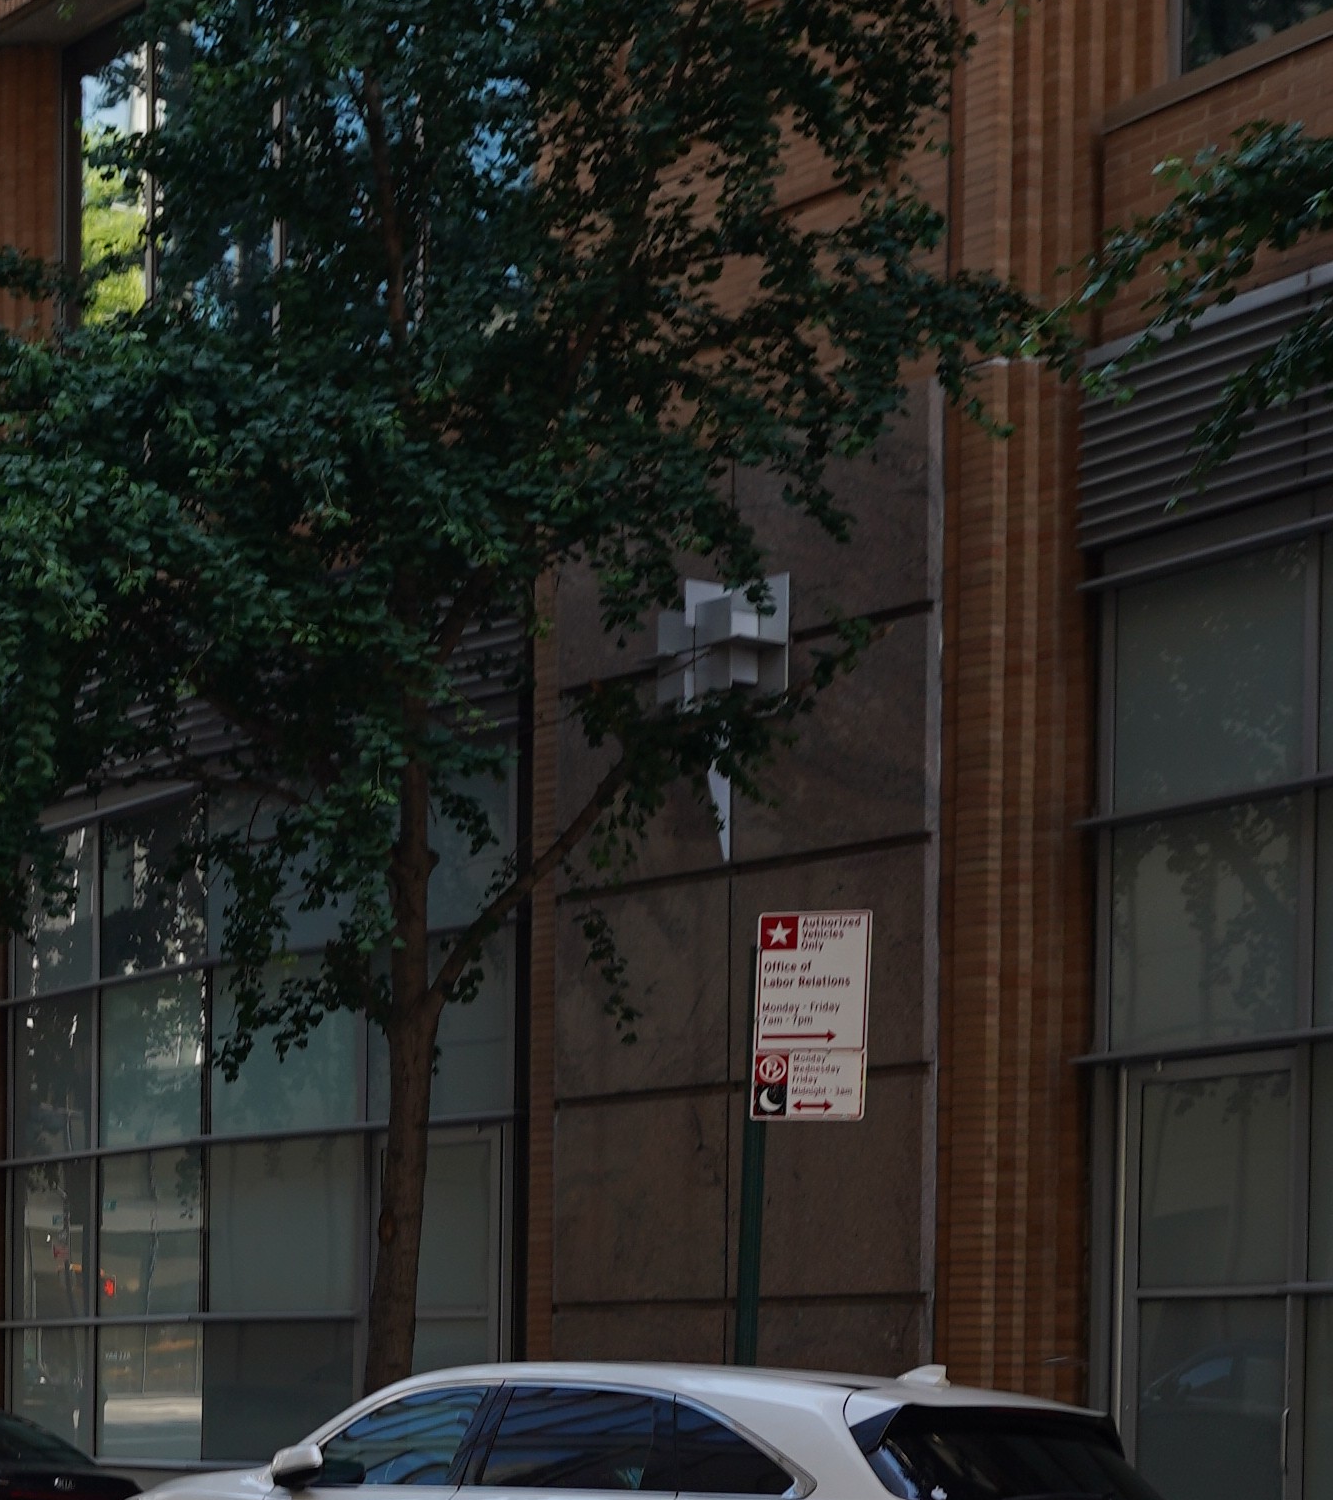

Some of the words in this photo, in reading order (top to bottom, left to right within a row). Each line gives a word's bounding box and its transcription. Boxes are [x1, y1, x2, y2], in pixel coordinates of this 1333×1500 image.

[802, 916, 861, 928] Authorized
[802, 927, 844, 939] Vehicles
[801, 940, 824, 952] Only
[764, 961, 797, 973] Office
[801, 960, 812, 972] of
[763, 977, 793, 988] Labor
[798, 975, 850, 988] Relations
[762, 1002, 800, 1014] Monday
[810, 1001, 840, 1014] Friday
